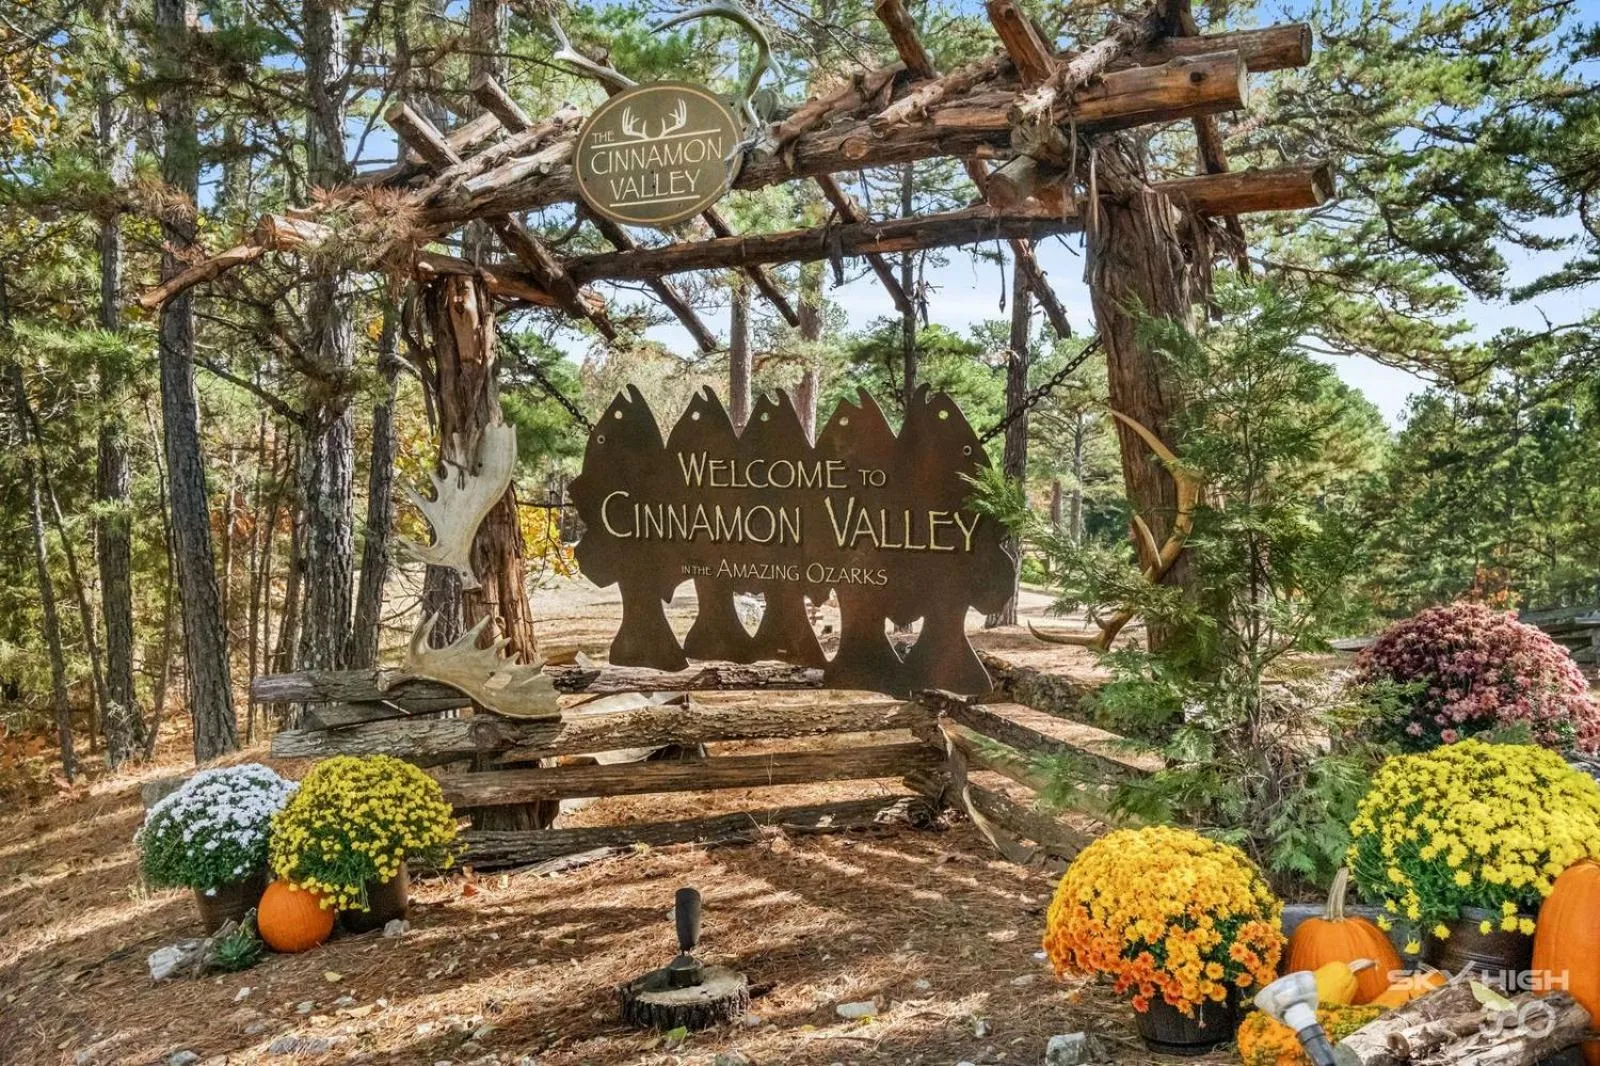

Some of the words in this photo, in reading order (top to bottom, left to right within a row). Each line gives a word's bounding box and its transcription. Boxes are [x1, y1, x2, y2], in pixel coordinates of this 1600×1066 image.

[591, 130, 615, 144] THE
[590, 136, 723, 176] CINNAMON
[609, 167, 701, 201] VALLEY
[677, 451, 849, 489] WELCOME
[857, 468, 887, 488] TO
[600, 490, 801, 545] CINNAMON
[823, 495, 981, 553] VALLEY
[680, 564, 692, 575] IN
[692, 565, 713, 576] THE
[716, 558, 800, 582] AMAZING
[806, 562, 889, 586] OZARKS
